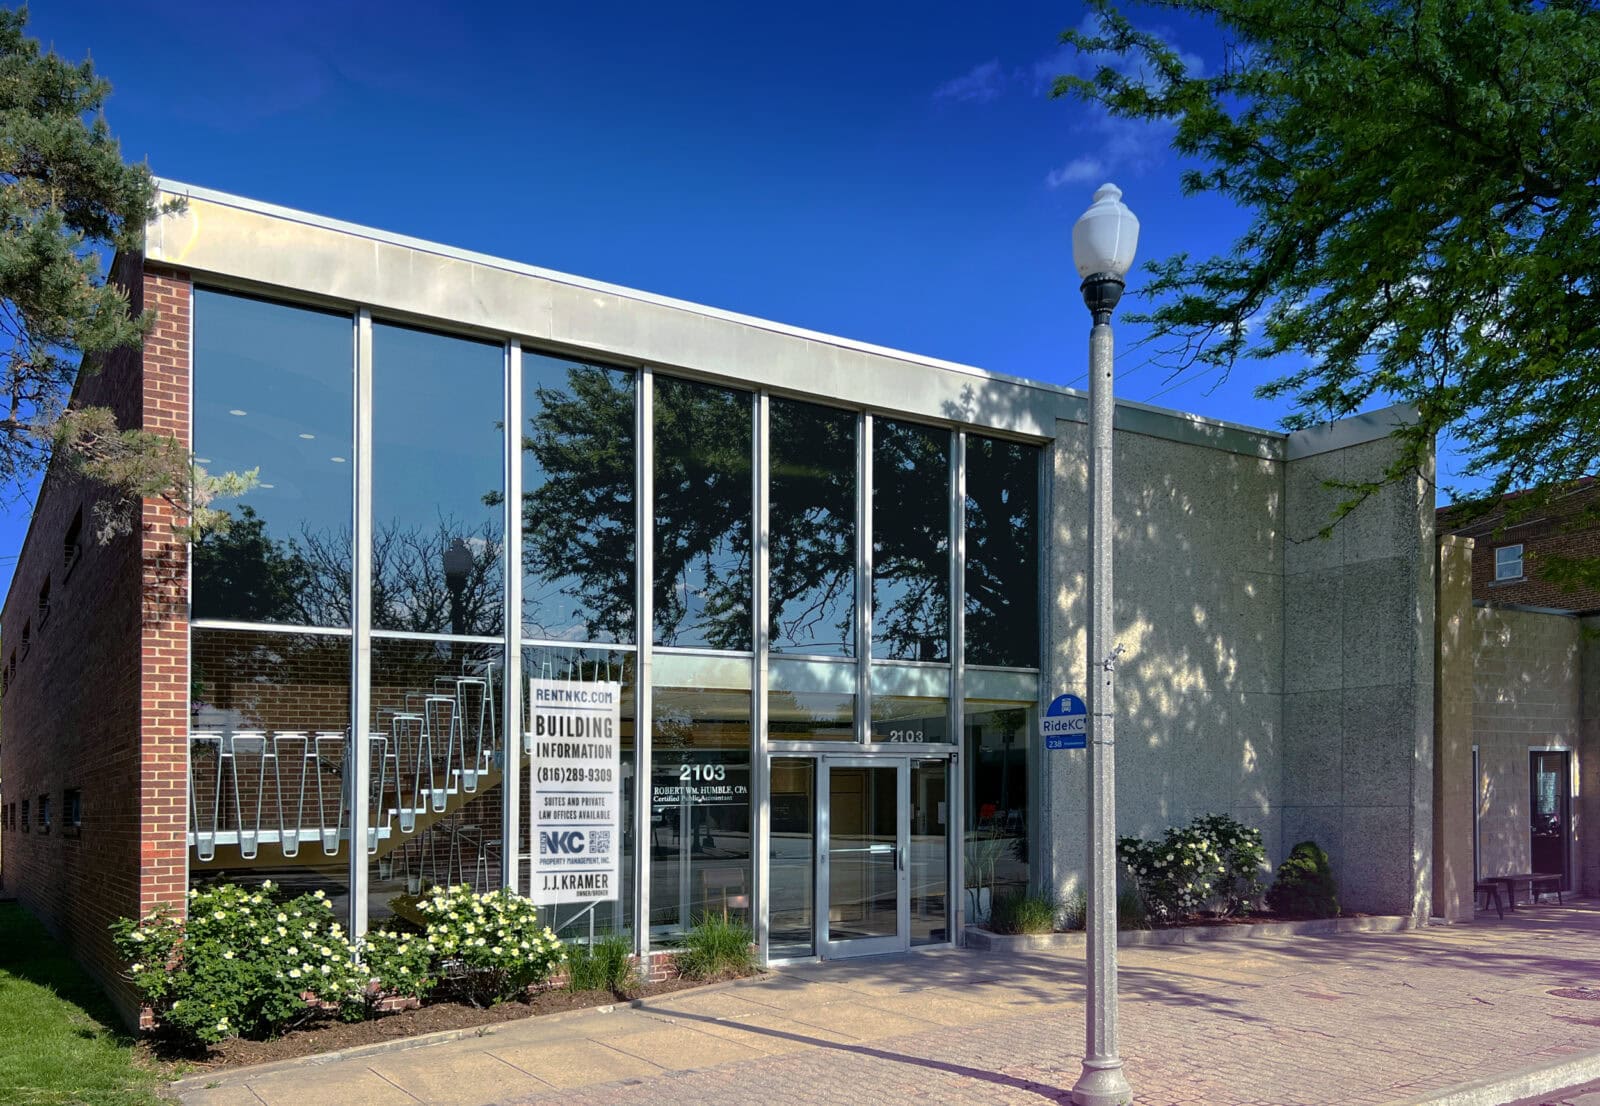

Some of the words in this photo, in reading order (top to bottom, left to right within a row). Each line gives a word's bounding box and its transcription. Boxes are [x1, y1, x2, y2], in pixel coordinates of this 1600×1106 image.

[536, 688, 613, 704] RENTNKC.COM
[536, 715, 613, 738] BUILDING
[1044, 718, 1083, 731] RideKC
[890, 730, 923, 742] 2103
[536, 742, 612, 759] INFORMATION
[1049, 740, 1062, 748] 238
[537, 766, 612, 783] (816)289-9309
[679, 764, 726, 780] 2103
[654, 786, 684, 795] ROBERT
[701, 786, 733, 794] HUMBLE,
[544, 797, 565, 806] SUITES
[567, 797, 579, 806] AND
[581, 797, 605, 806] PRIVATE
[539, 810, 552, 820] LAW
[553, 810, 577, 820] OFFICES
[579, 811, 611, 820] AVAILABLE
[546, 832, 584, 853] NKC
[539, 857, 565, 865] PROPERTY
[567, 857, 600, 865] MANAGEMENT,
